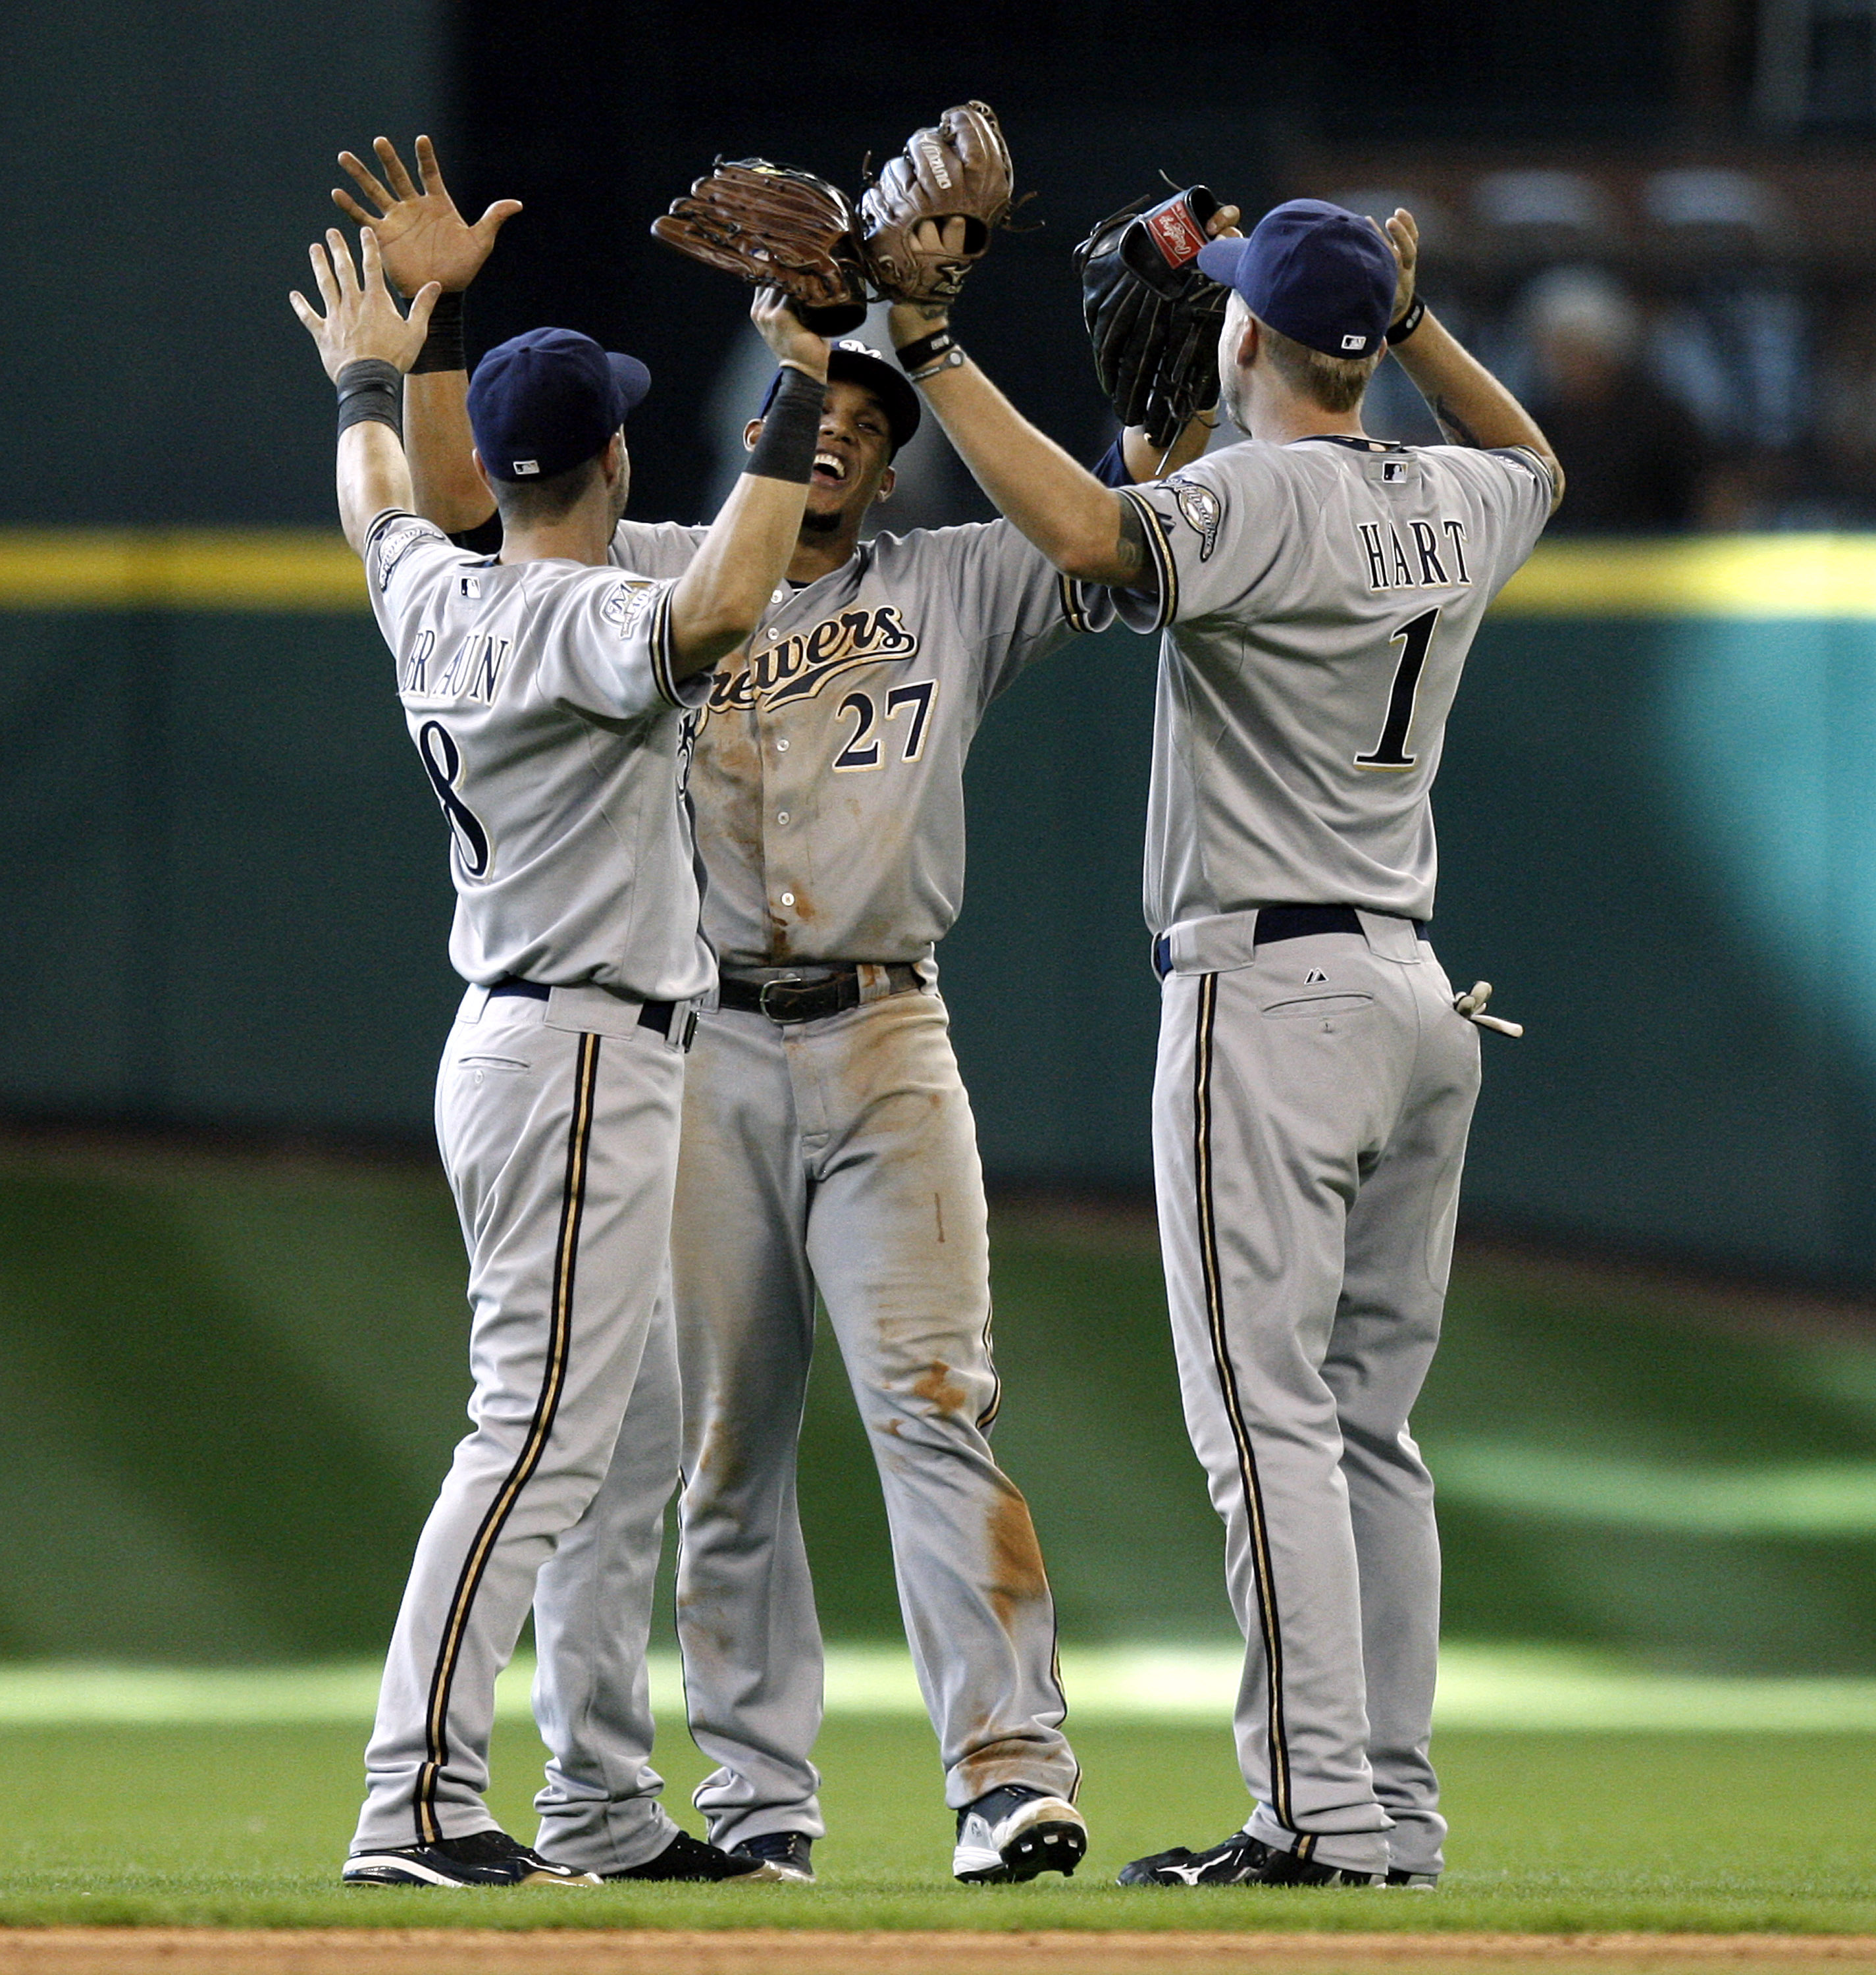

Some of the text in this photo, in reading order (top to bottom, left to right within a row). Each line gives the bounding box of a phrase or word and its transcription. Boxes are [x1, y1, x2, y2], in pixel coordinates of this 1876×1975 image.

[1357, 519, 1473, 592] HART
[703, 605, 920, 714] rewers
[1353, 604, 1442, 772] 1
[832, 679, 939, 773] 27
[418, 719, 491, 881] 8
